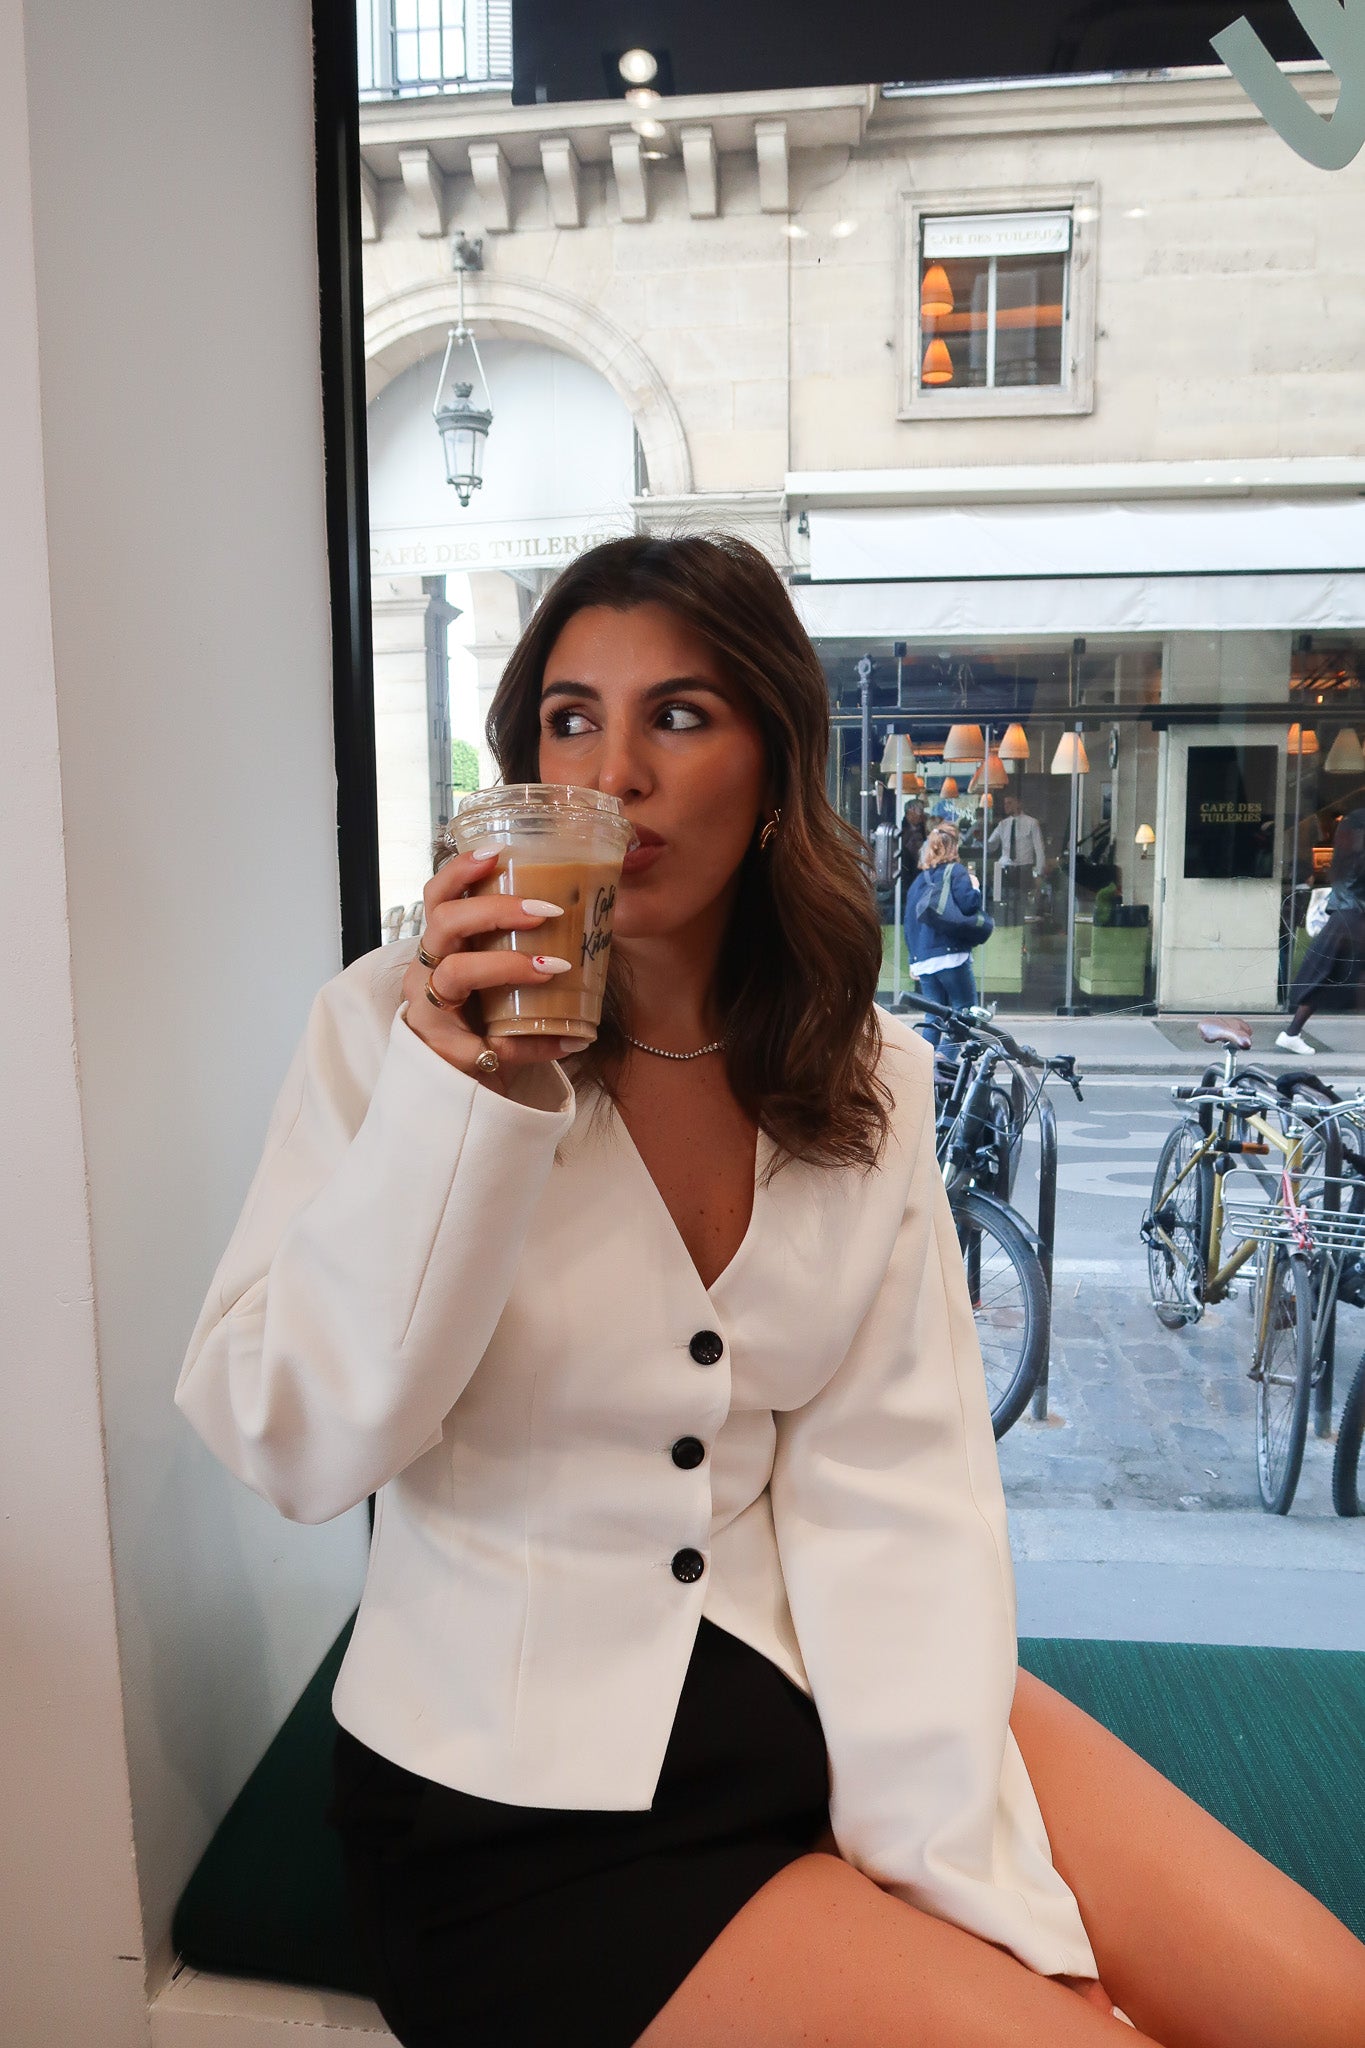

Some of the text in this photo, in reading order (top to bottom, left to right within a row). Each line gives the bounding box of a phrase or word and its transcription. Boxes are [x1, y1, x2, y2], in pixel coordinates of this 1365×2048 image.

[968, 231, 992, 244] DES
[435, 542, 480, 562] DES
[489, 532, 614, 559] TUILERIE
[1200, 801, 1262, 812] CAFÉ DES
[1200, 813, 1261, 822] TUILERIES
